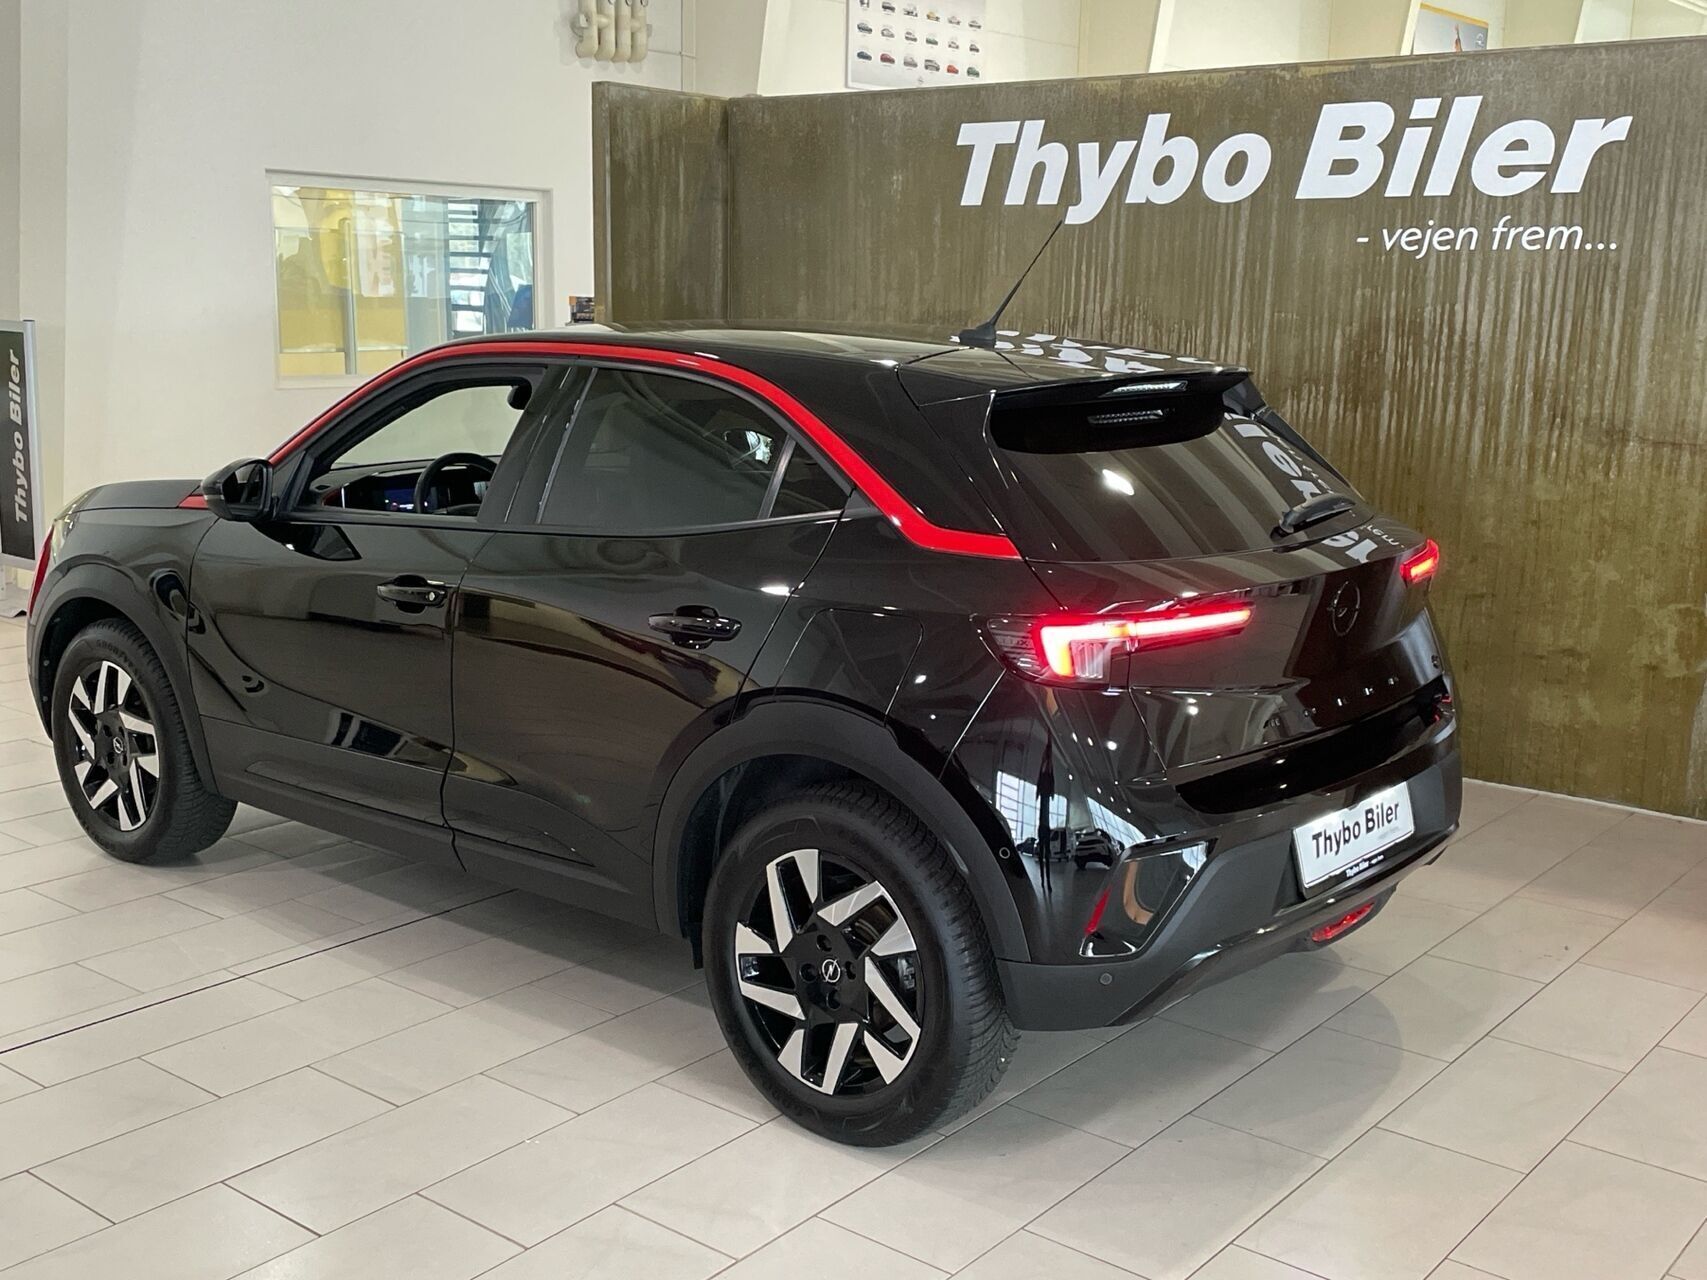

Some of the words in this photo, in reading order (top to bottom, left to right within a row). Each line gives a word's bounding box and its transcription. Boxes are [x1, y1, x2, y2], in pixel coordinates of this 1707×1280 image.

[956, 112, 1272, 225] Thybo
[1294, 95, 1635, 200] Biler
[1381, 219, 1480, 260] vejen
[1490, 215, 1619, 252] frem...
[8, 349, 22, 426] Biler
[13, 431, 28, 523] Thybo
[1311, 820, 1361, 859] Thybo
[1364, 802, 1399, 834] Biler
